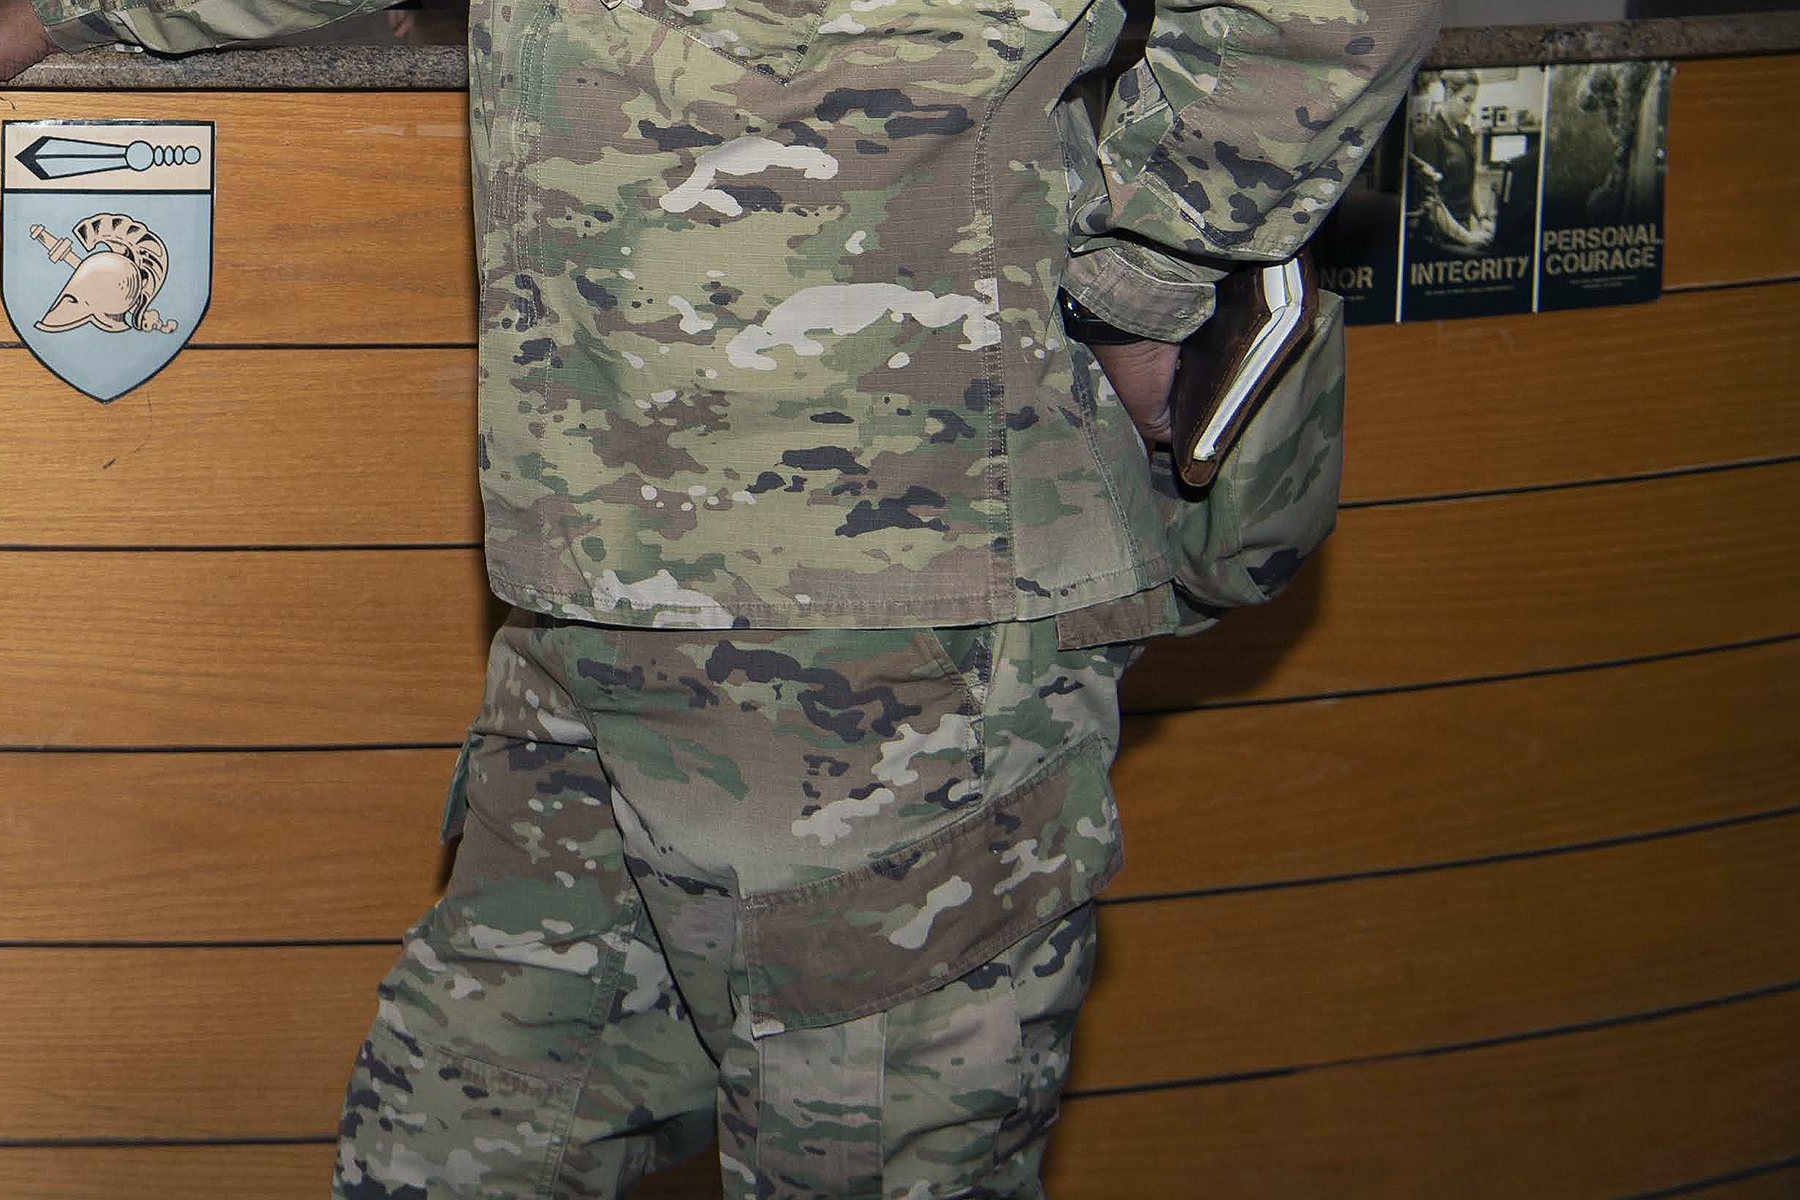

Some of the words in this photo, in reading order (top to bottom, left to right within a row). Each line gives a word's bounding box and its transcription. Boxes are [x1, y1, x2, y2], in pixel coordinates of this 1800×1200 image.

[1542, 223, 1662, 253] PERSONAL
[1410, 255, 1529, 286] INTEGRITY
[1545, 246, 1657, 276] COURAGE
[1319, 266, 1374, 290] NOR
